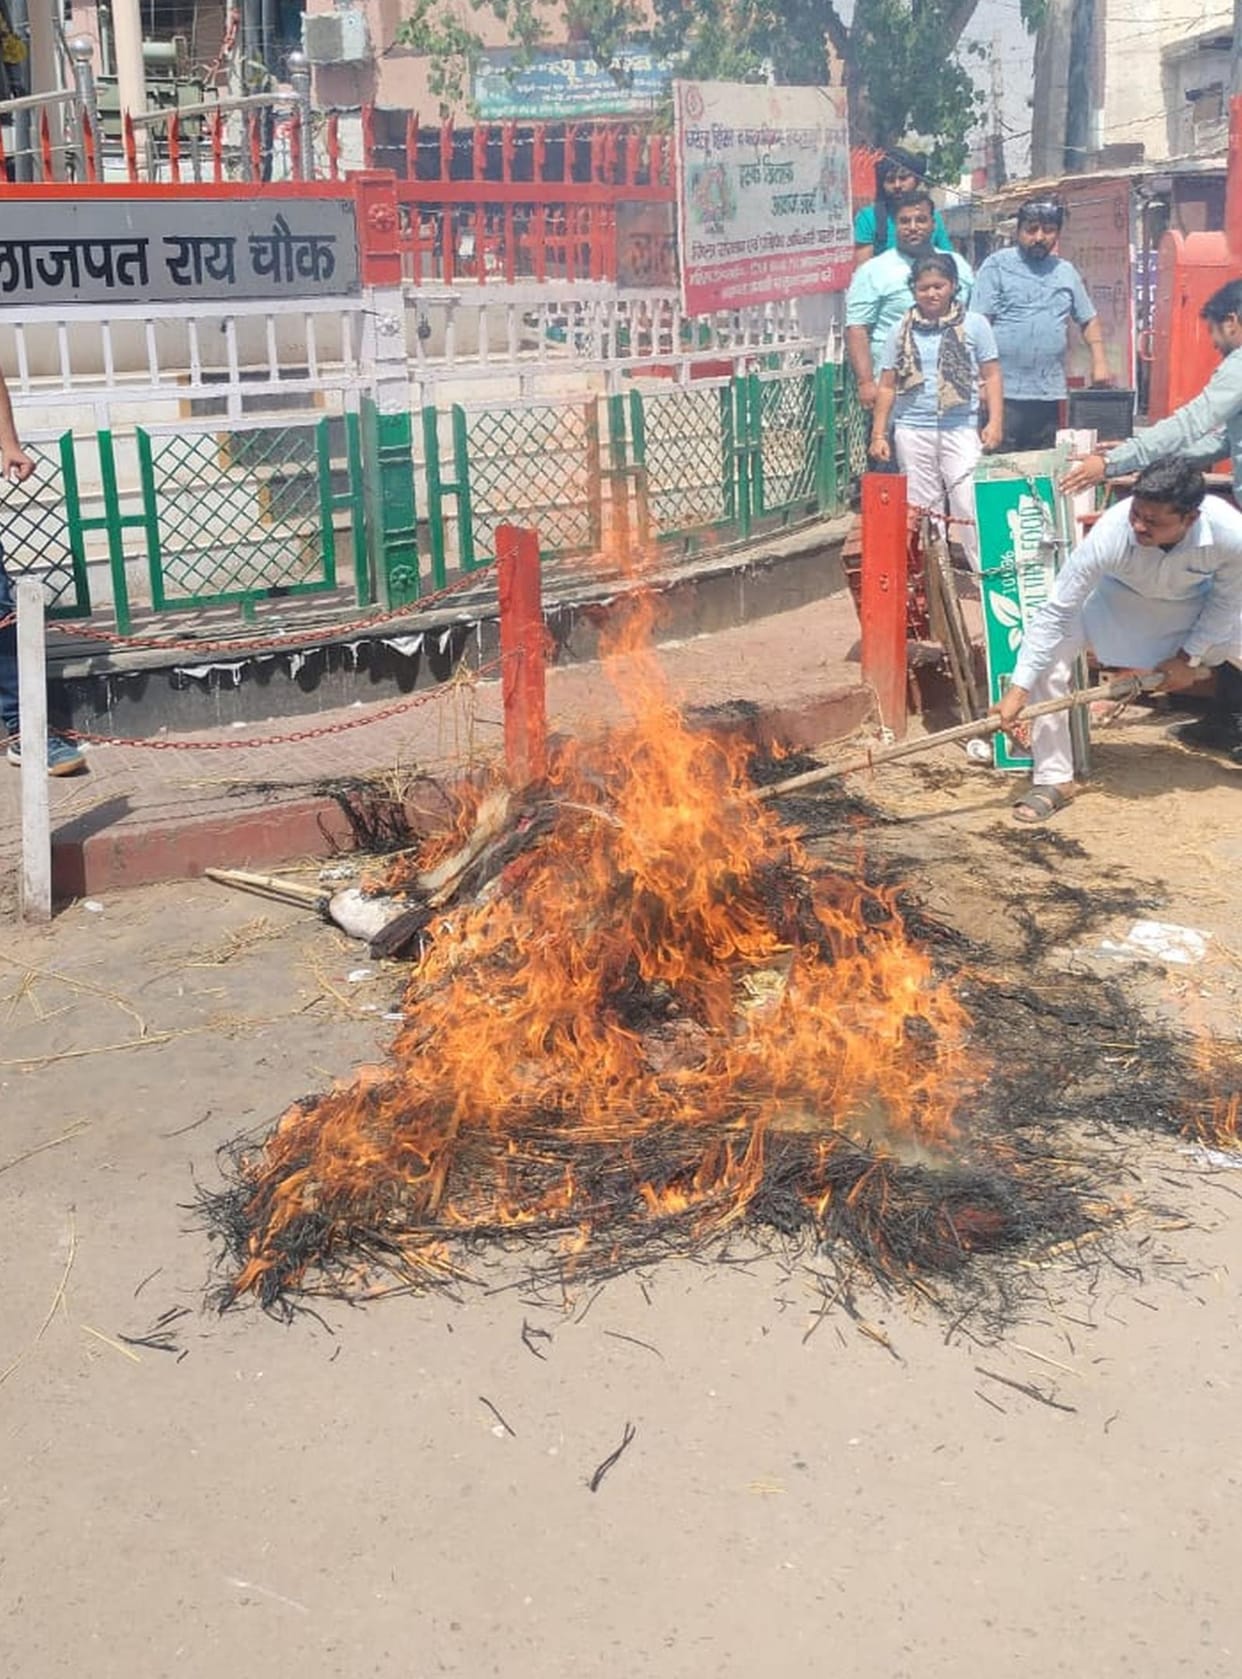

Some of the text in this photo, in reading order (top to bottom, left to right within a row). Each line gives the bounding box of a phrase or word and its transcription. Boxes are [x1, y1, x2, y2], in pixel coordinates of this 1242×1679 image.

[163, 236, 236, 286] राय
[248, 213, 337, 284] चौक
[1019, 507, 1043, 551] FOOD
